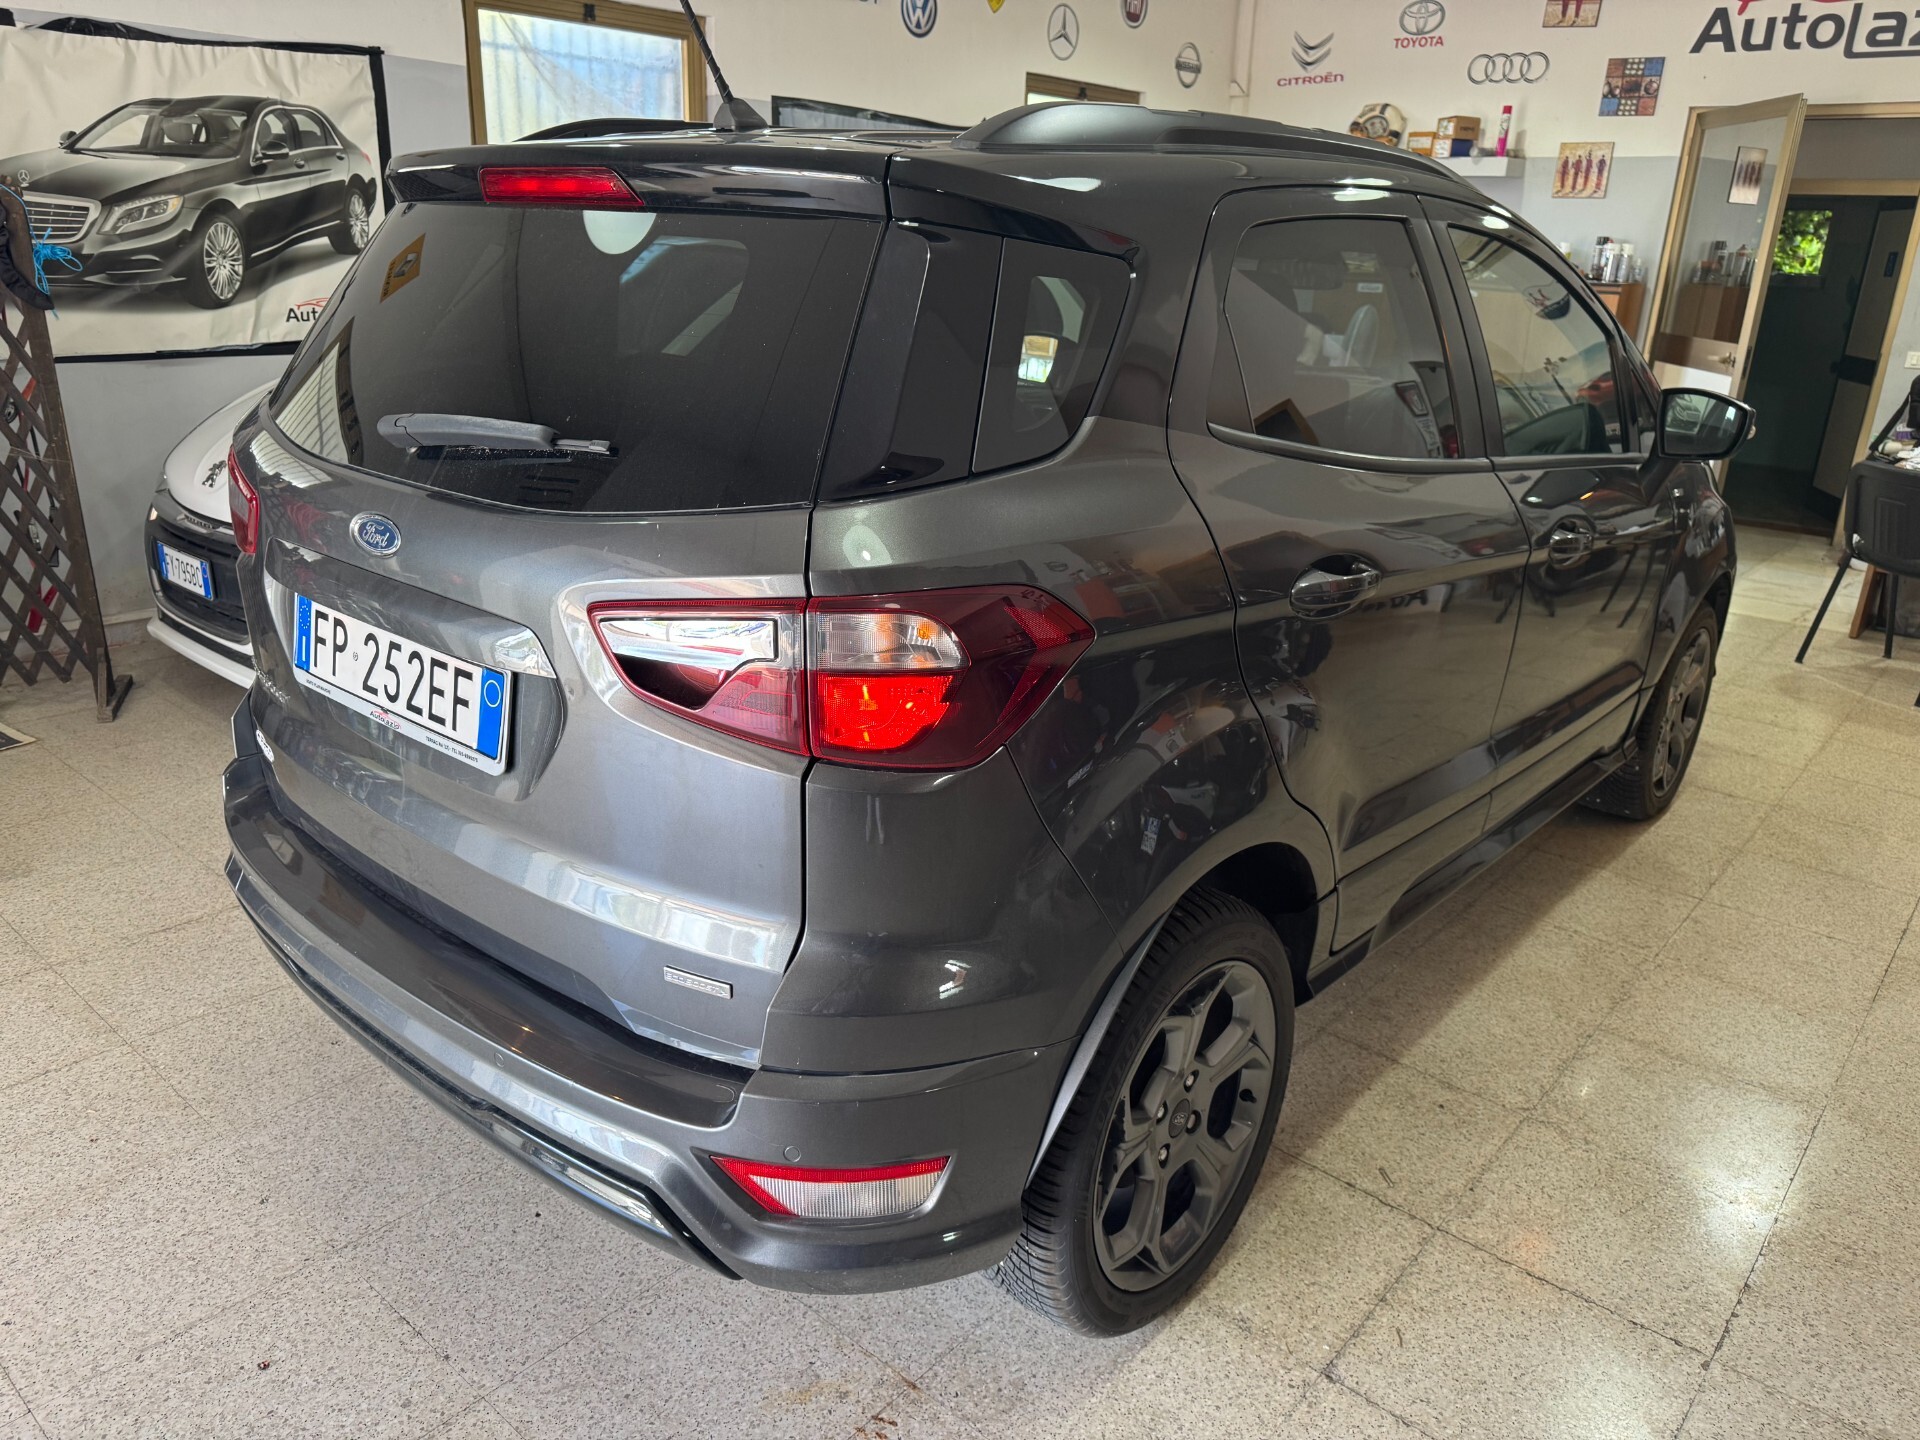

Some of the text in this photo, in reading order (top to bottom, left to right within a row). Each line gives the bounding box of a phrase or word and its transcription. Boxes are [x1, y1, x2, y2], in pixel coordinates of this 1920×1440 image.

[1393, 36, 1444, 49] TOYOTA
[362, 521, 390, 547] Ford
[313, 609, 348, 677] FP
[362, 632, 474, 732] 252EF
